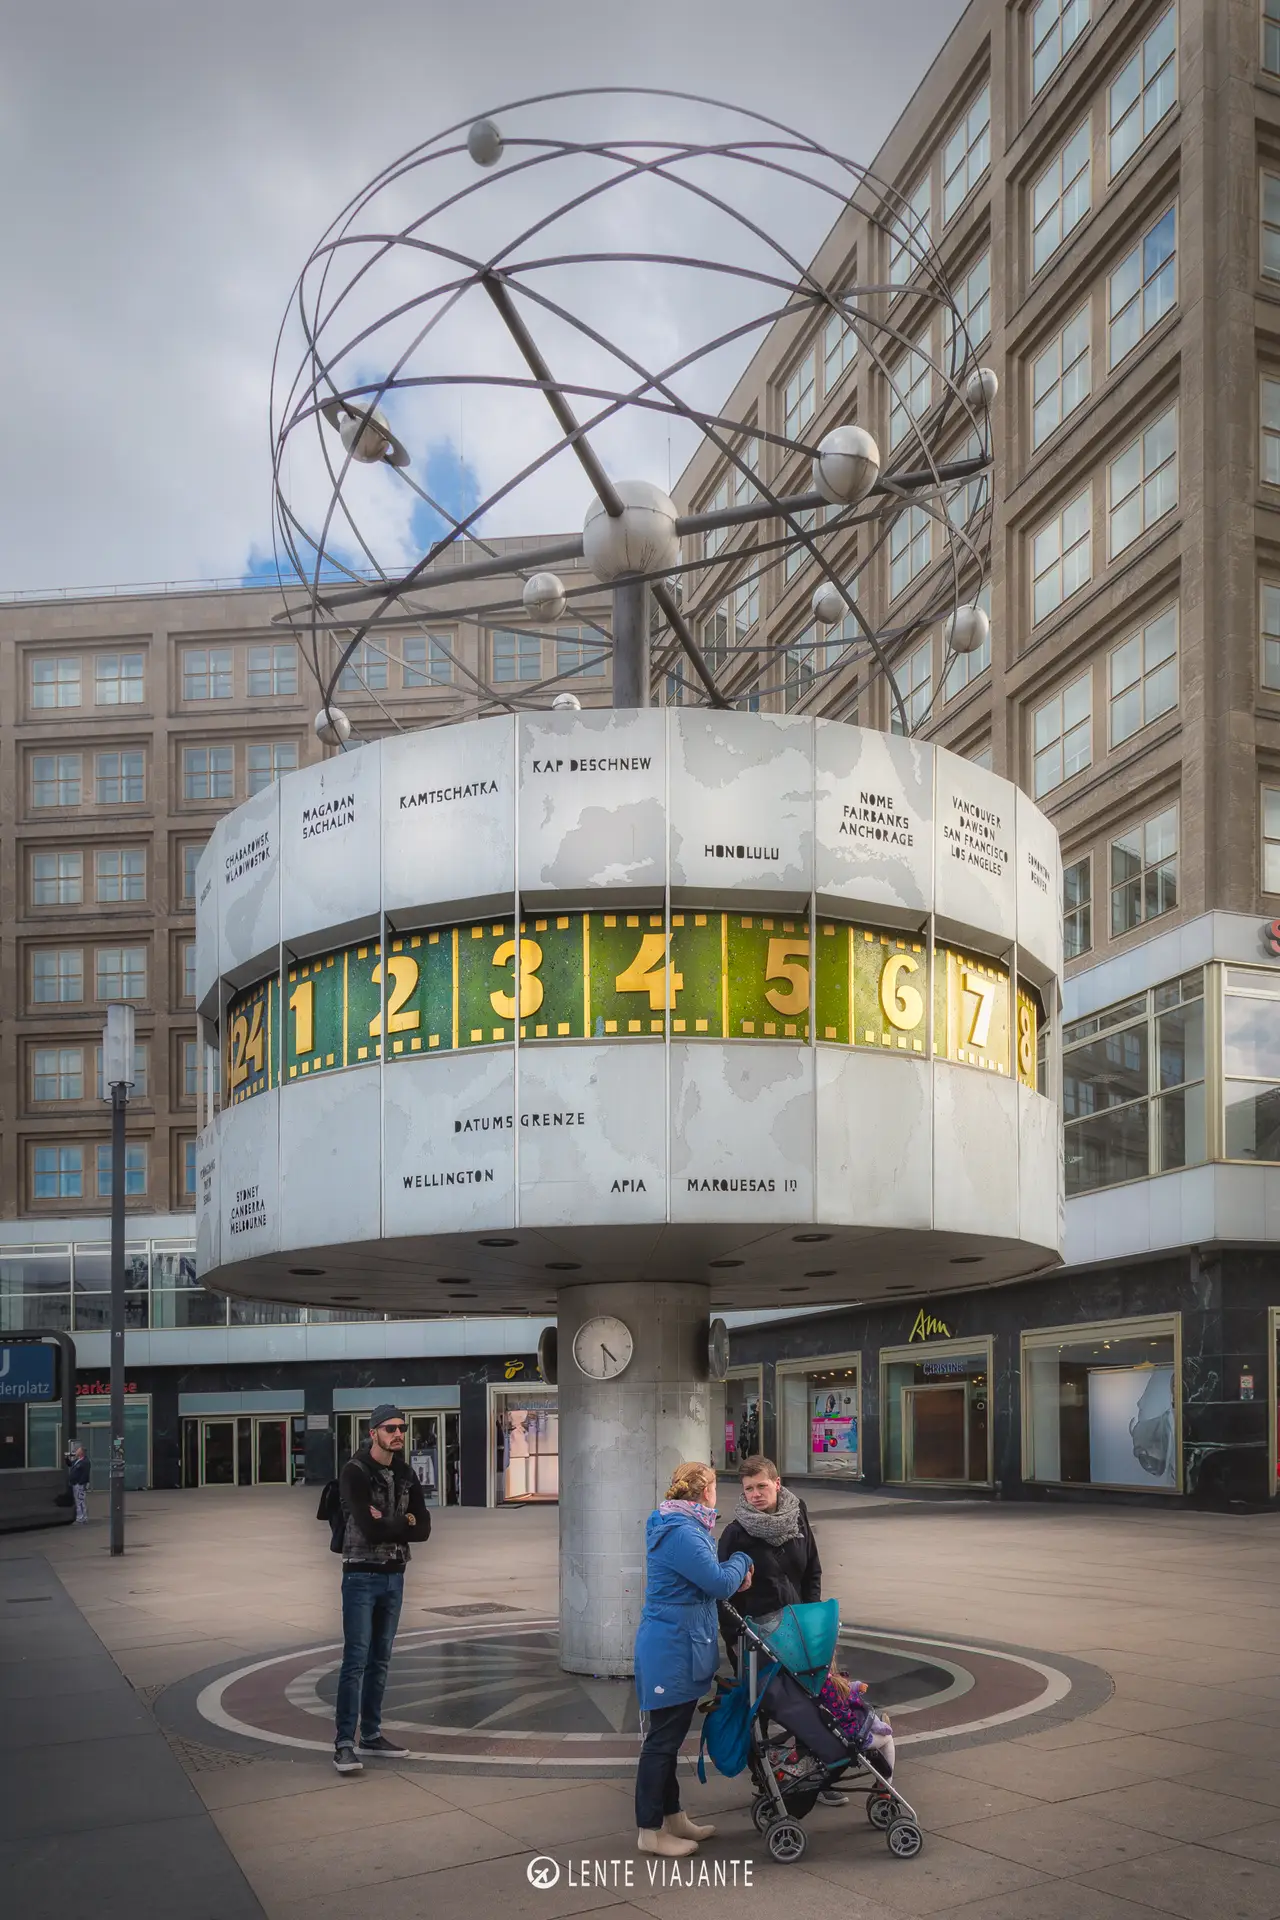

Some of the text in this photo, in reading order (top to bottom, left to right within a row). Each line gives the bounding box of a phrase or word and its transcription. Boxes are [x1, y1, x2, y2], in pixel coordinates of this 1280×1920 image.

[533, 757, 651, 773] KAP DESCHNEW
[303, 794, 354, 823] MAGADAN
[400, 780, 498, 809] KAMTSCHATKA
[860, 791, 893, 810] NOME
[303, 810, 354, 839] SACHALIN
[843, 805, 909, 829] FAIRBANKS
[953, 796, 1001, 829] VANCOUVER
[839, 822, 914, 847] ANCHORAGE
[960, 816, 995, 841] DAWSON
[225, 831, 269, 869] CHABAROWSK
[704, 845, 779, 860] HONOLULU
[944, 826, 1008, 863] SAN FRANCISCO
[225, 847, 270, 884] WLADIWOSTOK
[951, 845, 1002, 876] LOS ANGELES
[489, 939, 543, 1019] 3
[615, 933, 683, 1010] 4
[764, 938, 809, 1016] 5
[369, 955, 420, 1037] 2
[880, 954, 923, 1030] 6
[289, 981, 314, 1055] 1
[962, 973, 996, 1048] 7
[232, 1001, 264, 1088] 24
[1018, 1005, 1032, 1075] 8
[403, 1169, 494, 1188] WELLINGTON
[611, 1179, 647, 1193] APIA
[687, 1178, 776, 1192] MARQUESAS
[236, 1185, 259, 1202] SYDNEY
[231, 1199, 265, 1219] CANBERRA
[230, 1214, 266, 1235] MELBOURNE
